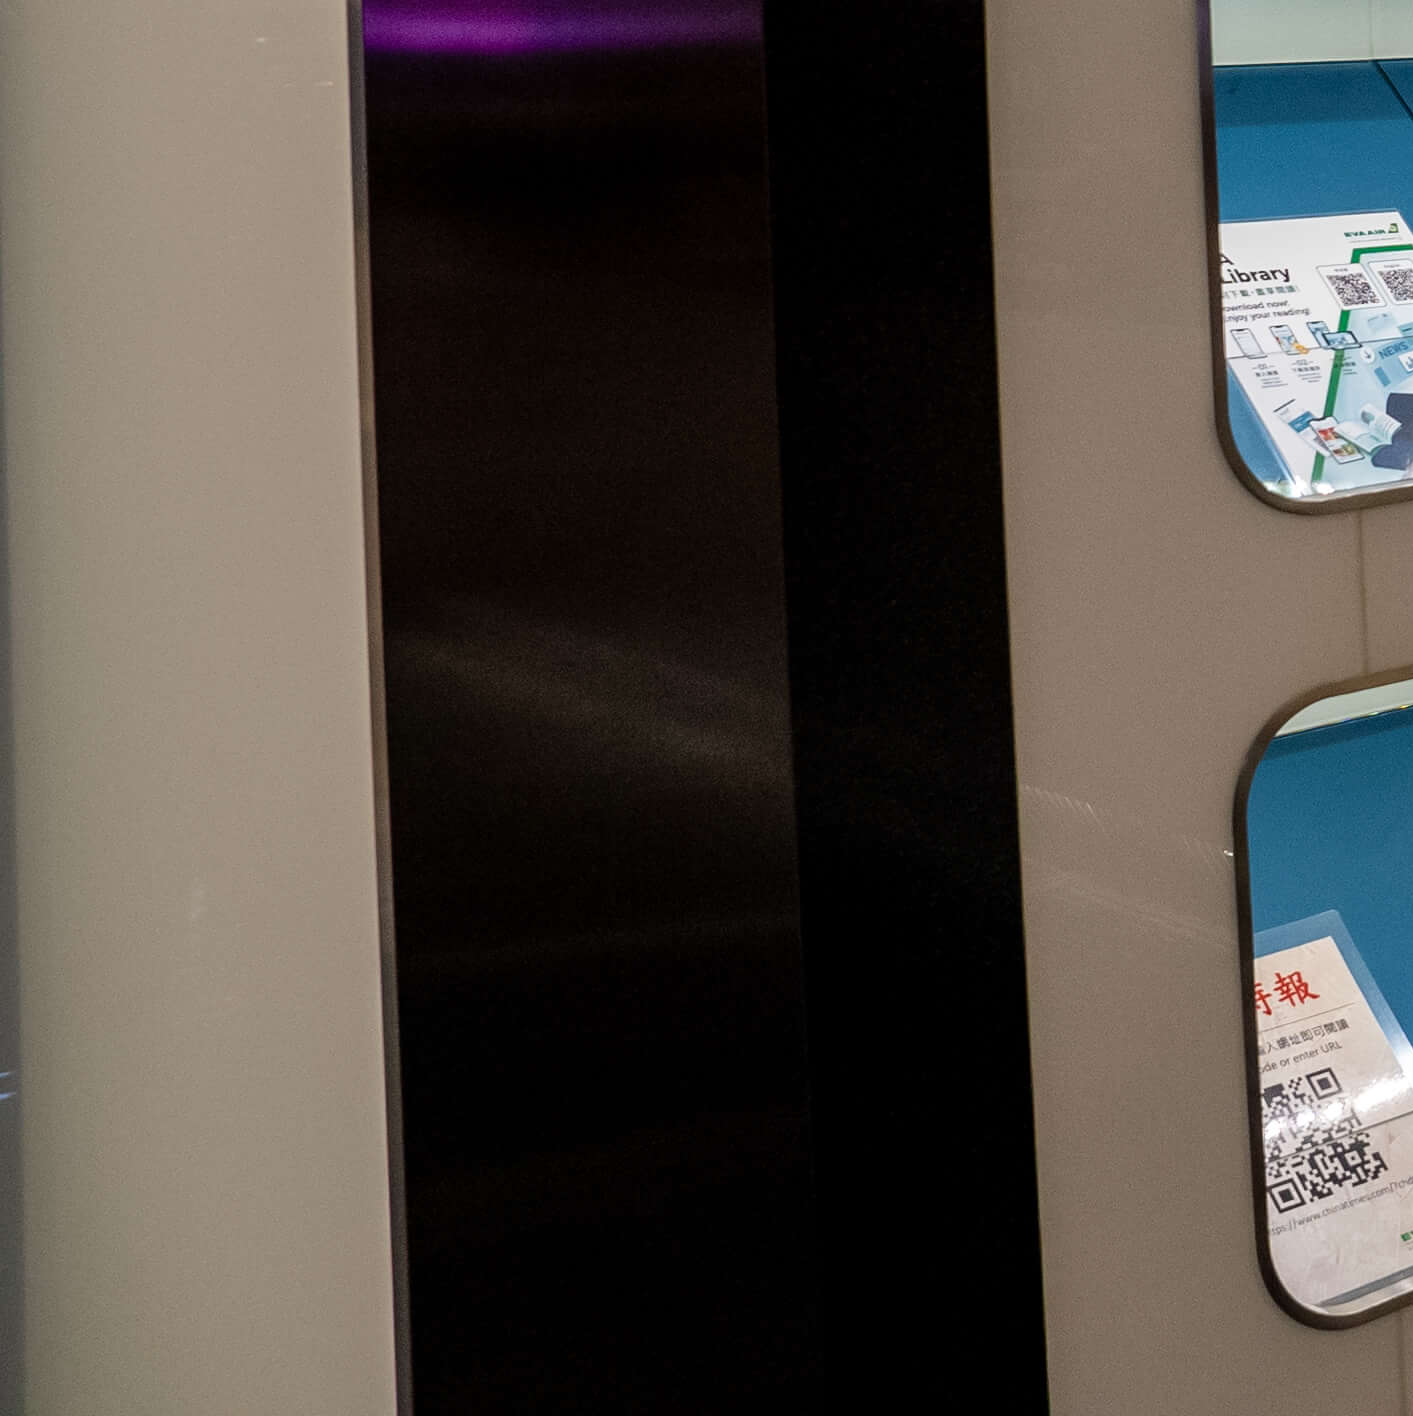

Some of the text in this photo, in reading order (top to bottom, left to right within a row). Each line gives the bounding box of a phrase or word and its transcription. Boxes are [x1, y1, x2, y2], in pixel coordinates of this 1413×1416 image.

[1378, 341, 1409, 359] NEWS
[1280, 1055, 1290, 1066] or
[1293, 1048, 1319, 1062] enter
[1320, 1041, 1342, 1053] URL
